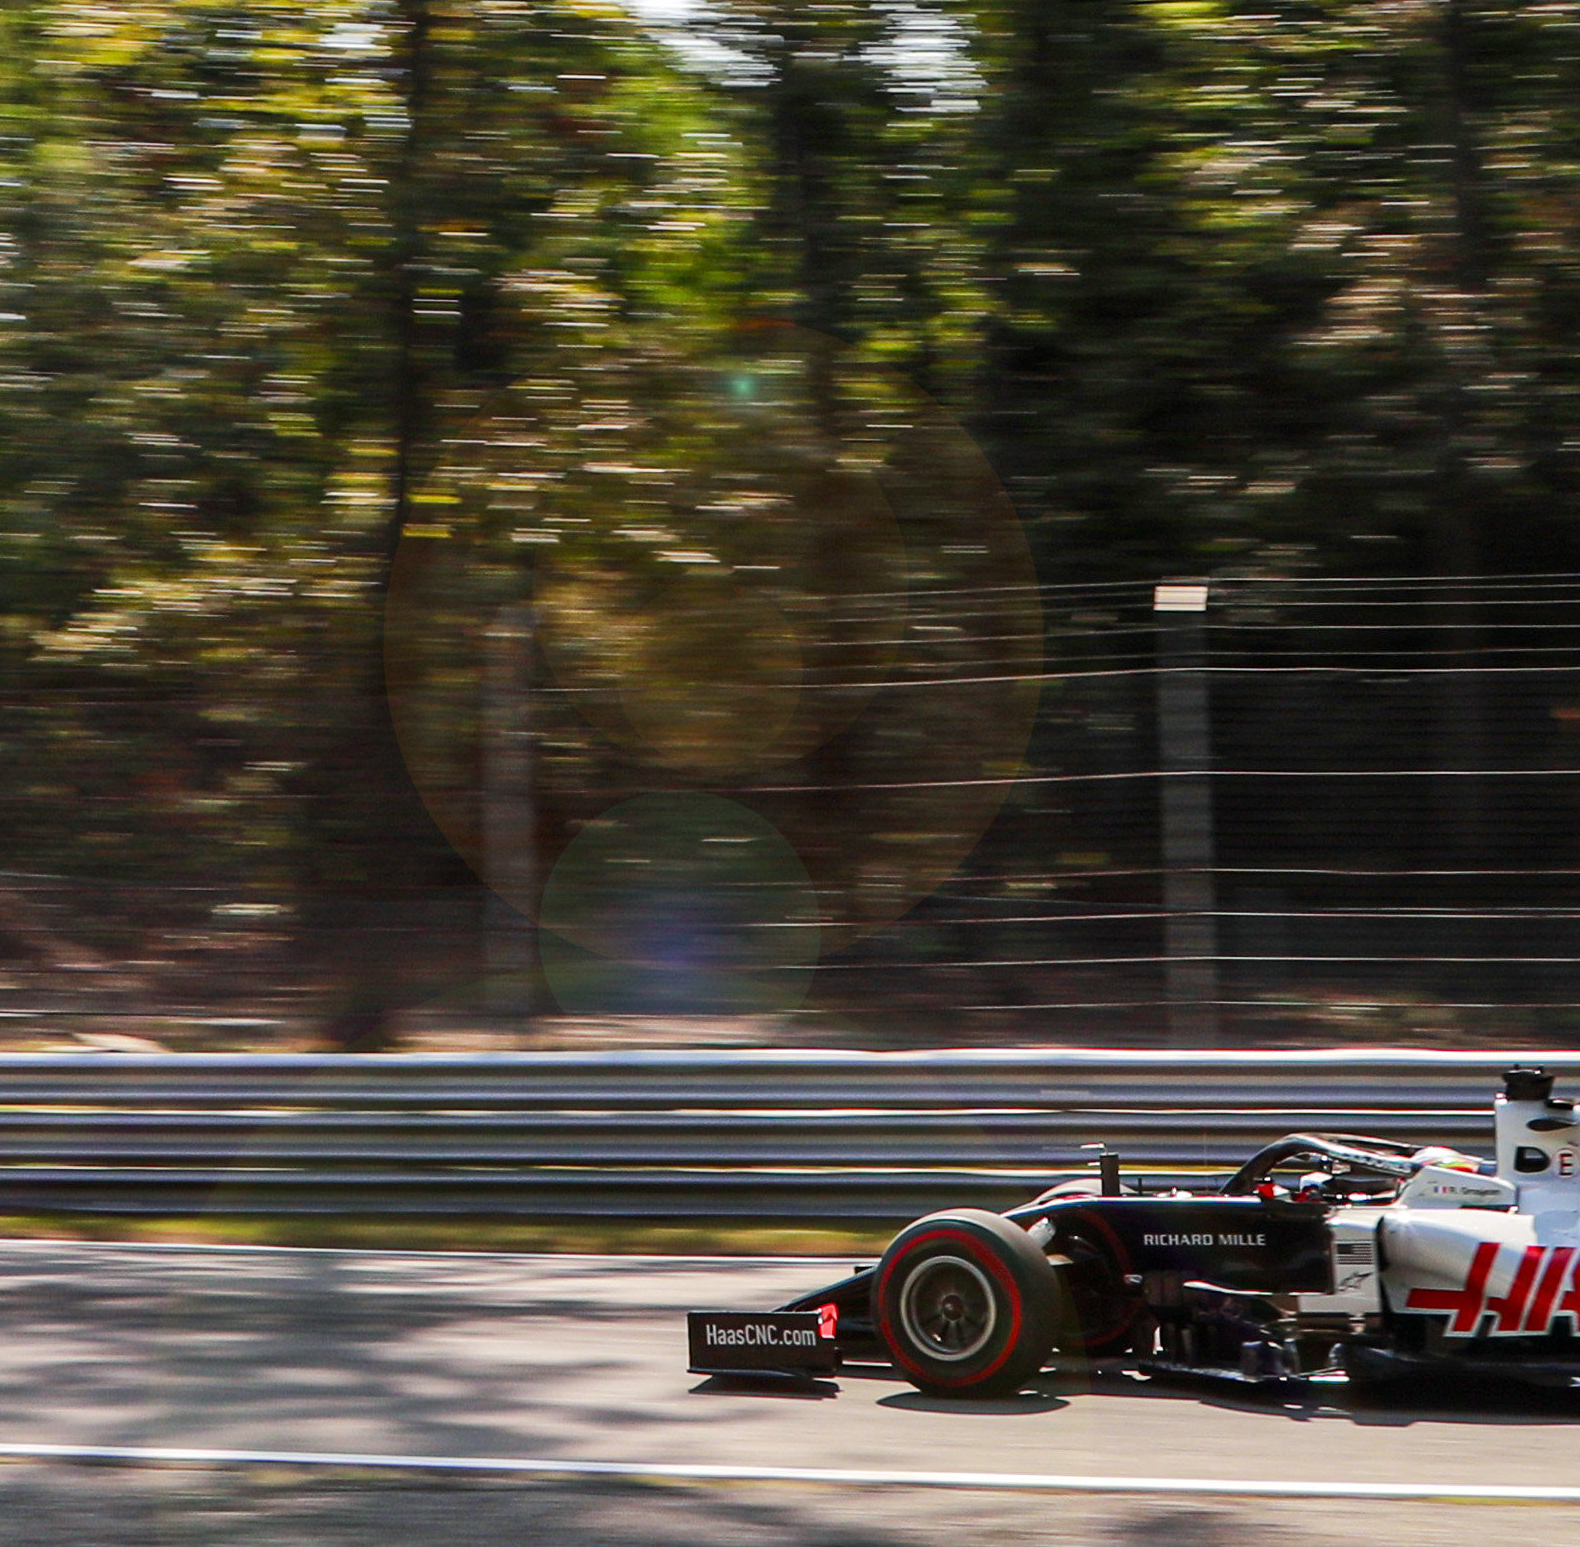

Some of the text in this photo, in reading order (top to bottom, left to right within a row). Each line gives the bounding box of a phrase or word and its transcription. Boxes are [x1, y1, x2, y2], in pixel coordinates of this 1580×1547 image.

[1558, 1153, 1573, 1175] E
[1144, 1234, 1266, 1246] RICHARD MILLE
[705, 1324, 817, 1346] HaasCNC.com
